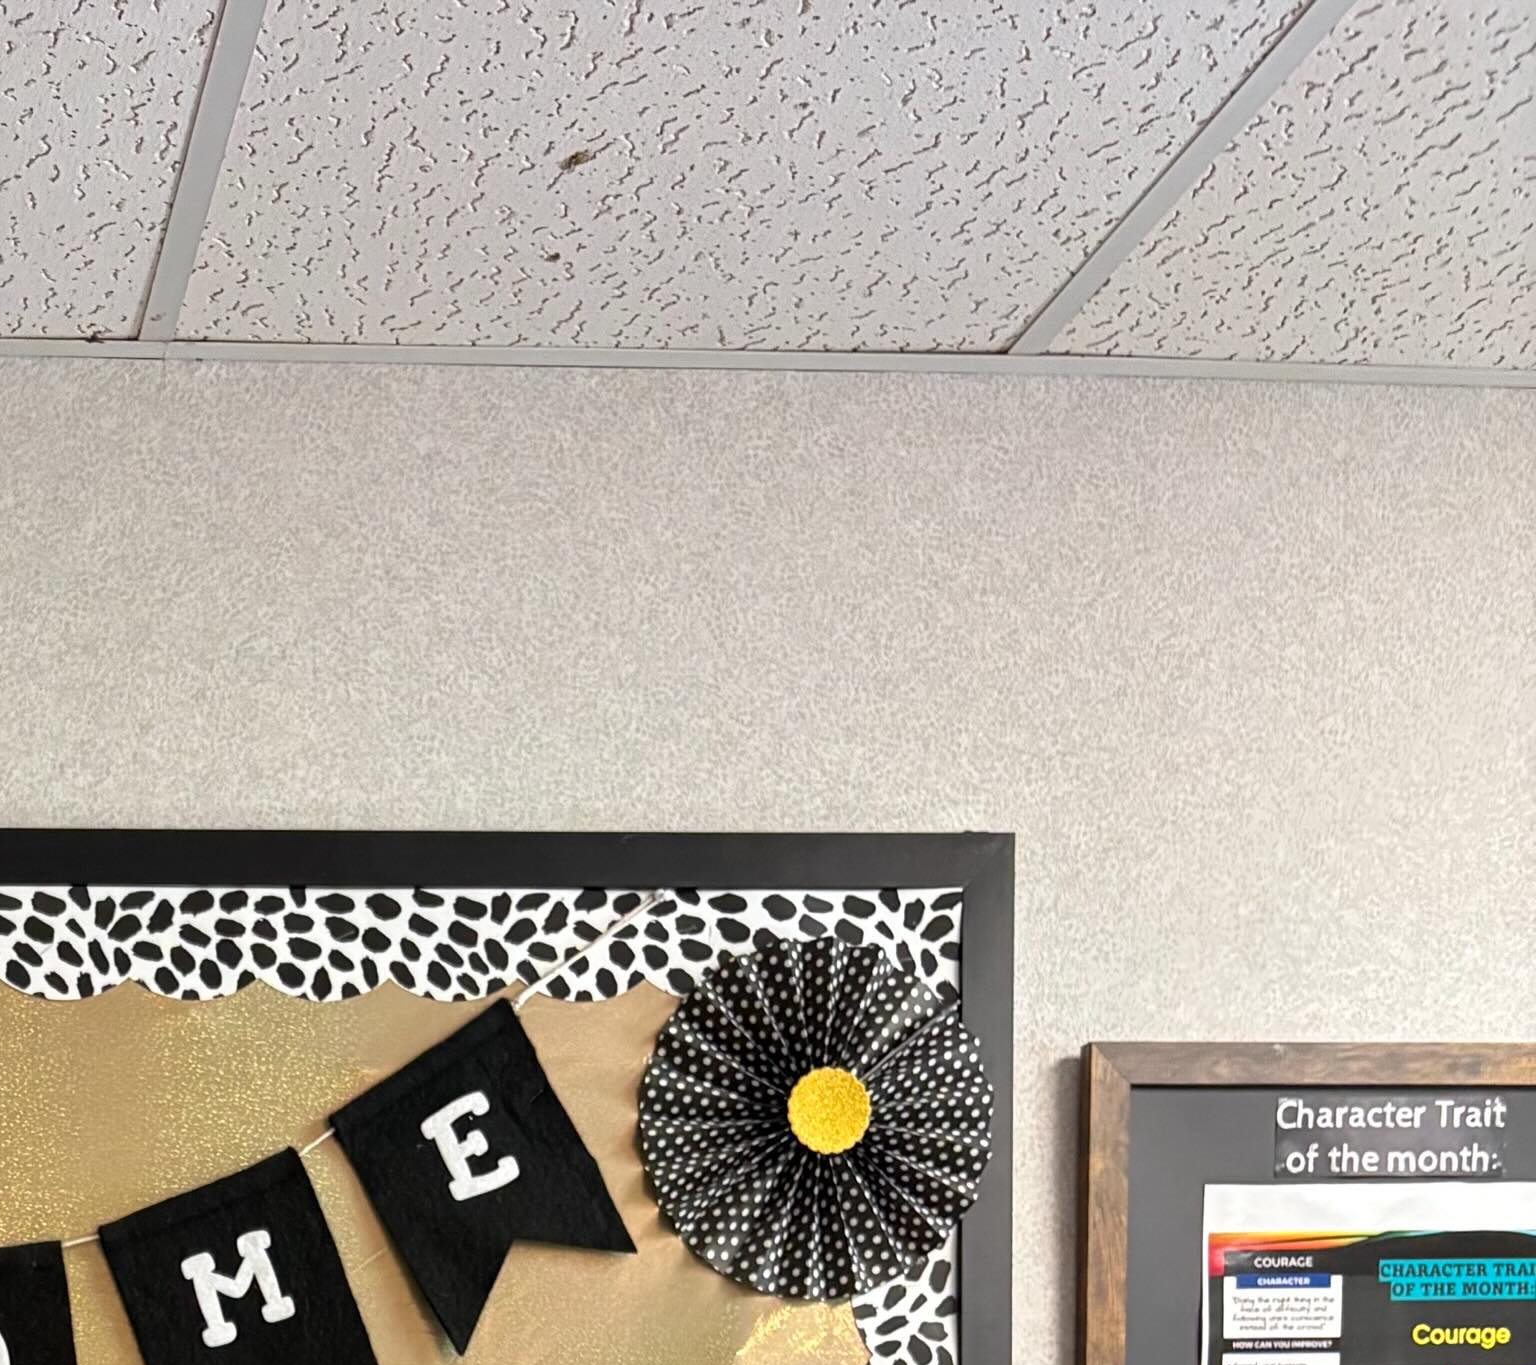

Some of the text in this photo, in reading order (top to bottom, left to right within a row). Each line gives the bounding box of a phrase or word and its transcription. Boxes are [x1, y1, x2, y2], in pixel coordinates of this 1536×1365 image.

[1277, 1097, 1506, 1129] Character Trait
[1285, 1144, 1500, 1173] of the month:
[1254, 1256, 1313, 1268] COURAGE
[1381, 1264, 1487, 1277] CHARACTER
[1257, 1277, 1310, 1285] CHARACTER
[1393, 1282, 1535, 1296] OF THE MONTH:
[1413, 1324, 1511, 1349] Courage
[1255, 1341, 1272, 1349] CAN
